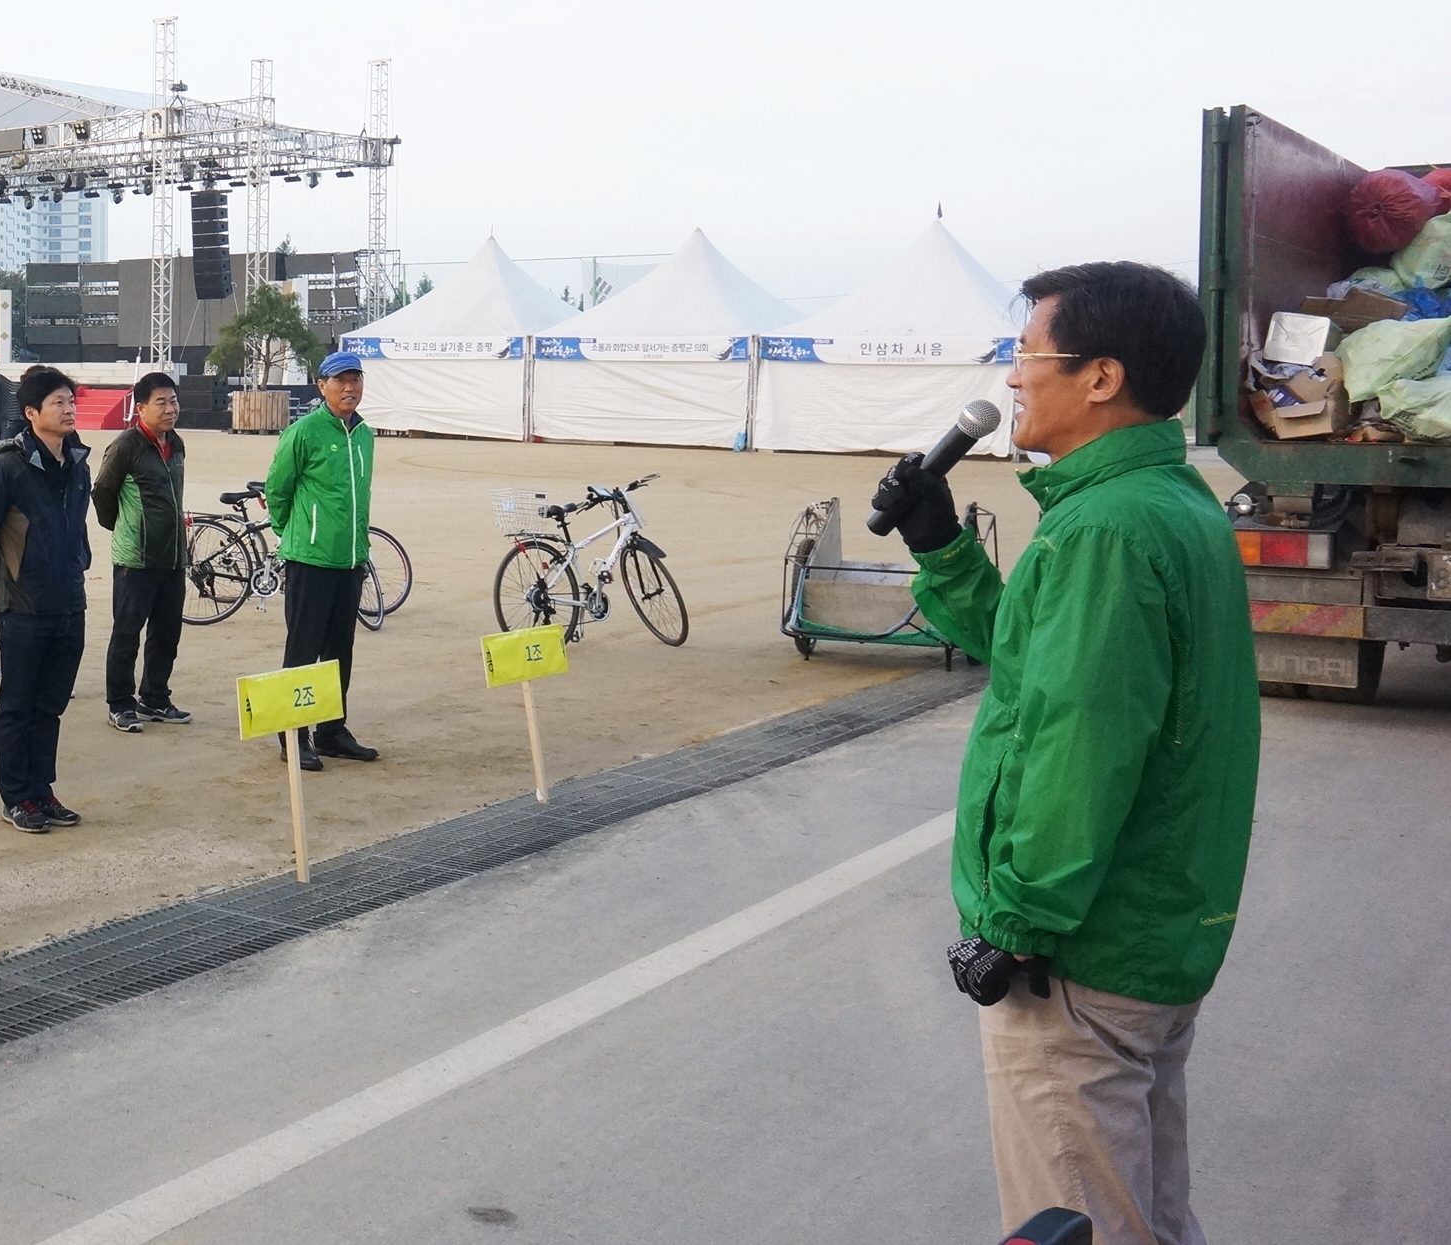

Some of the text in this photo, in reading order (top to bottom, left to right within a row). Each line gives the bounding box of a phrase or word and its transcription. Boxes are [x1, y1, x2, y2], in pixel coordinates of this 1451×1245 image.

[394, 341, 493, 352] 전국 최고의 살기좋은 증평
[591, 343, 709, 353] 소통과 화합으로 앞서가는 증평군 의회
[860, 342, 943, 356] 인삼차 시음
[525, 644, 543, 662] 1조
[293, 686, 316, 708] 2조
